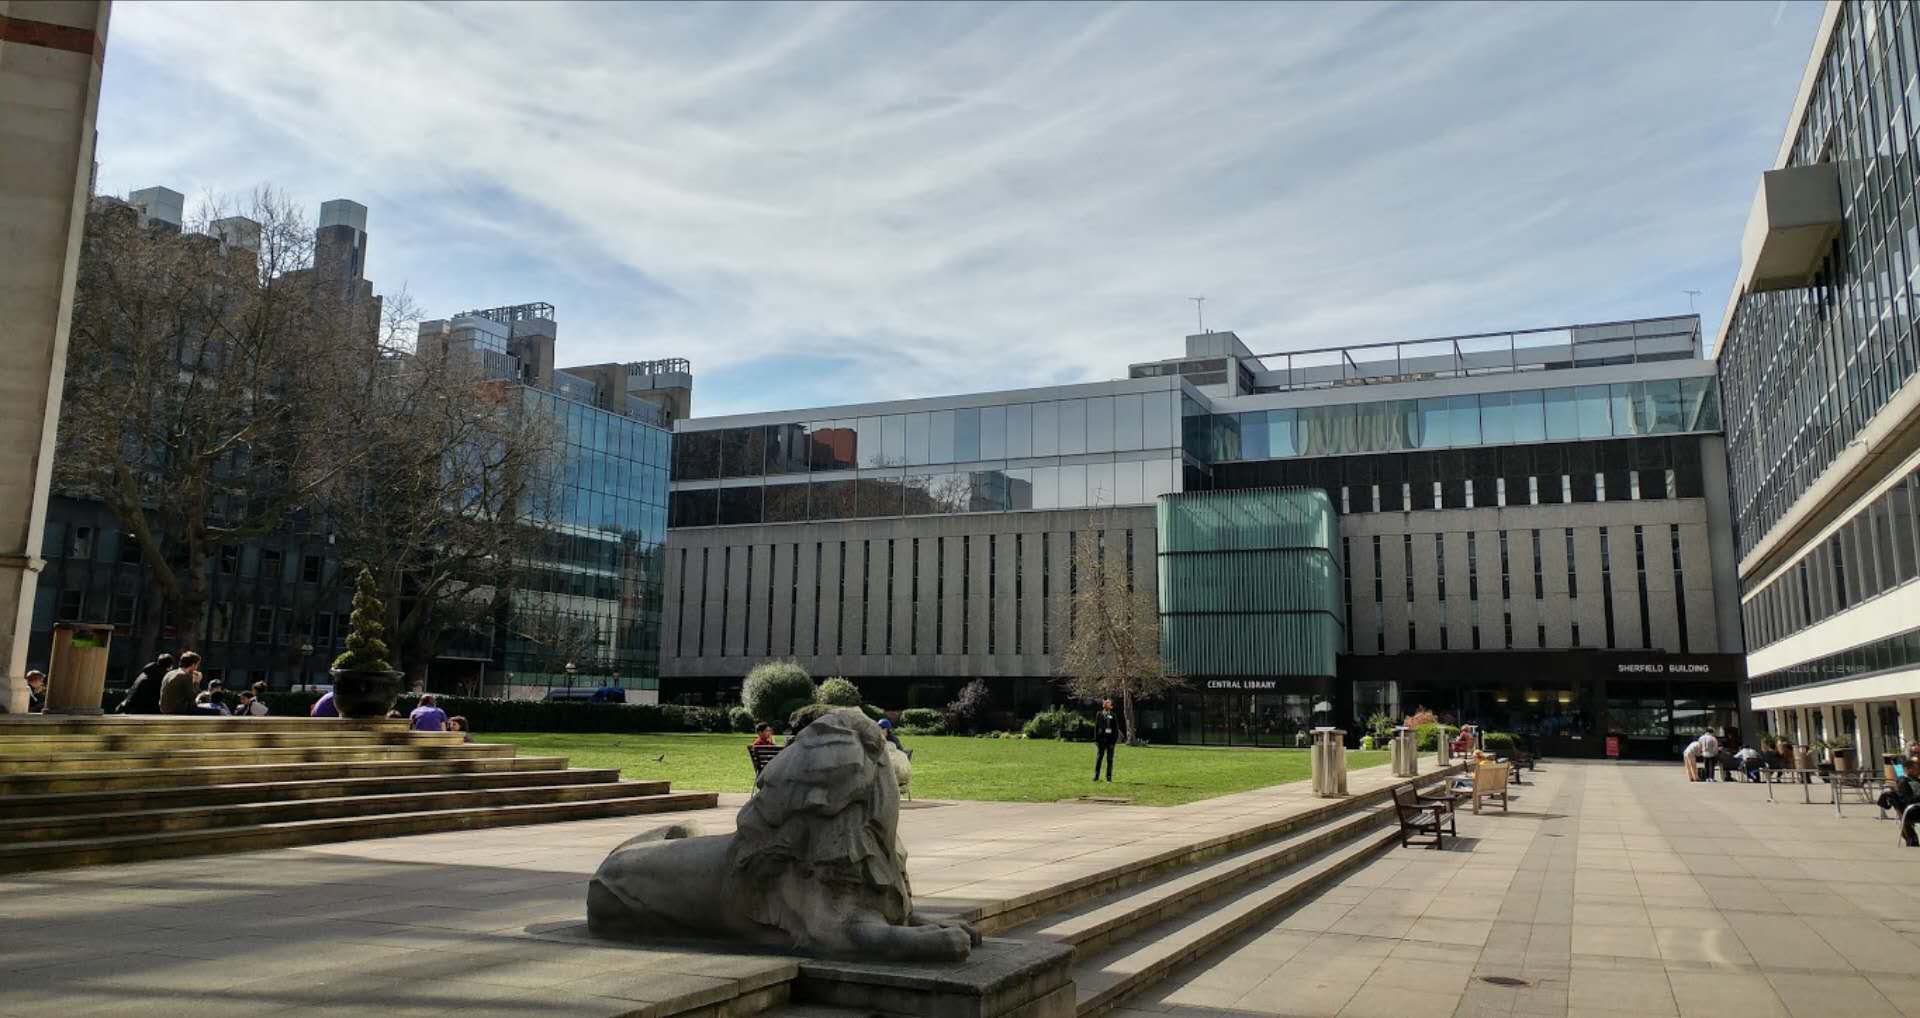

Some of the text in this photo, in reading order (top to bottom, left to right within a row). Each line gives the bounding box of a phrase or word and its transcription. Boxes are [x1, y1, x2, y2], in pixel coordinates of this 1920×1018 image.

[1618, 664, 1709, 672] SHERFIELD BUILDING
[1207, 680, 1276, 689] CENTRAL LIBRARY
